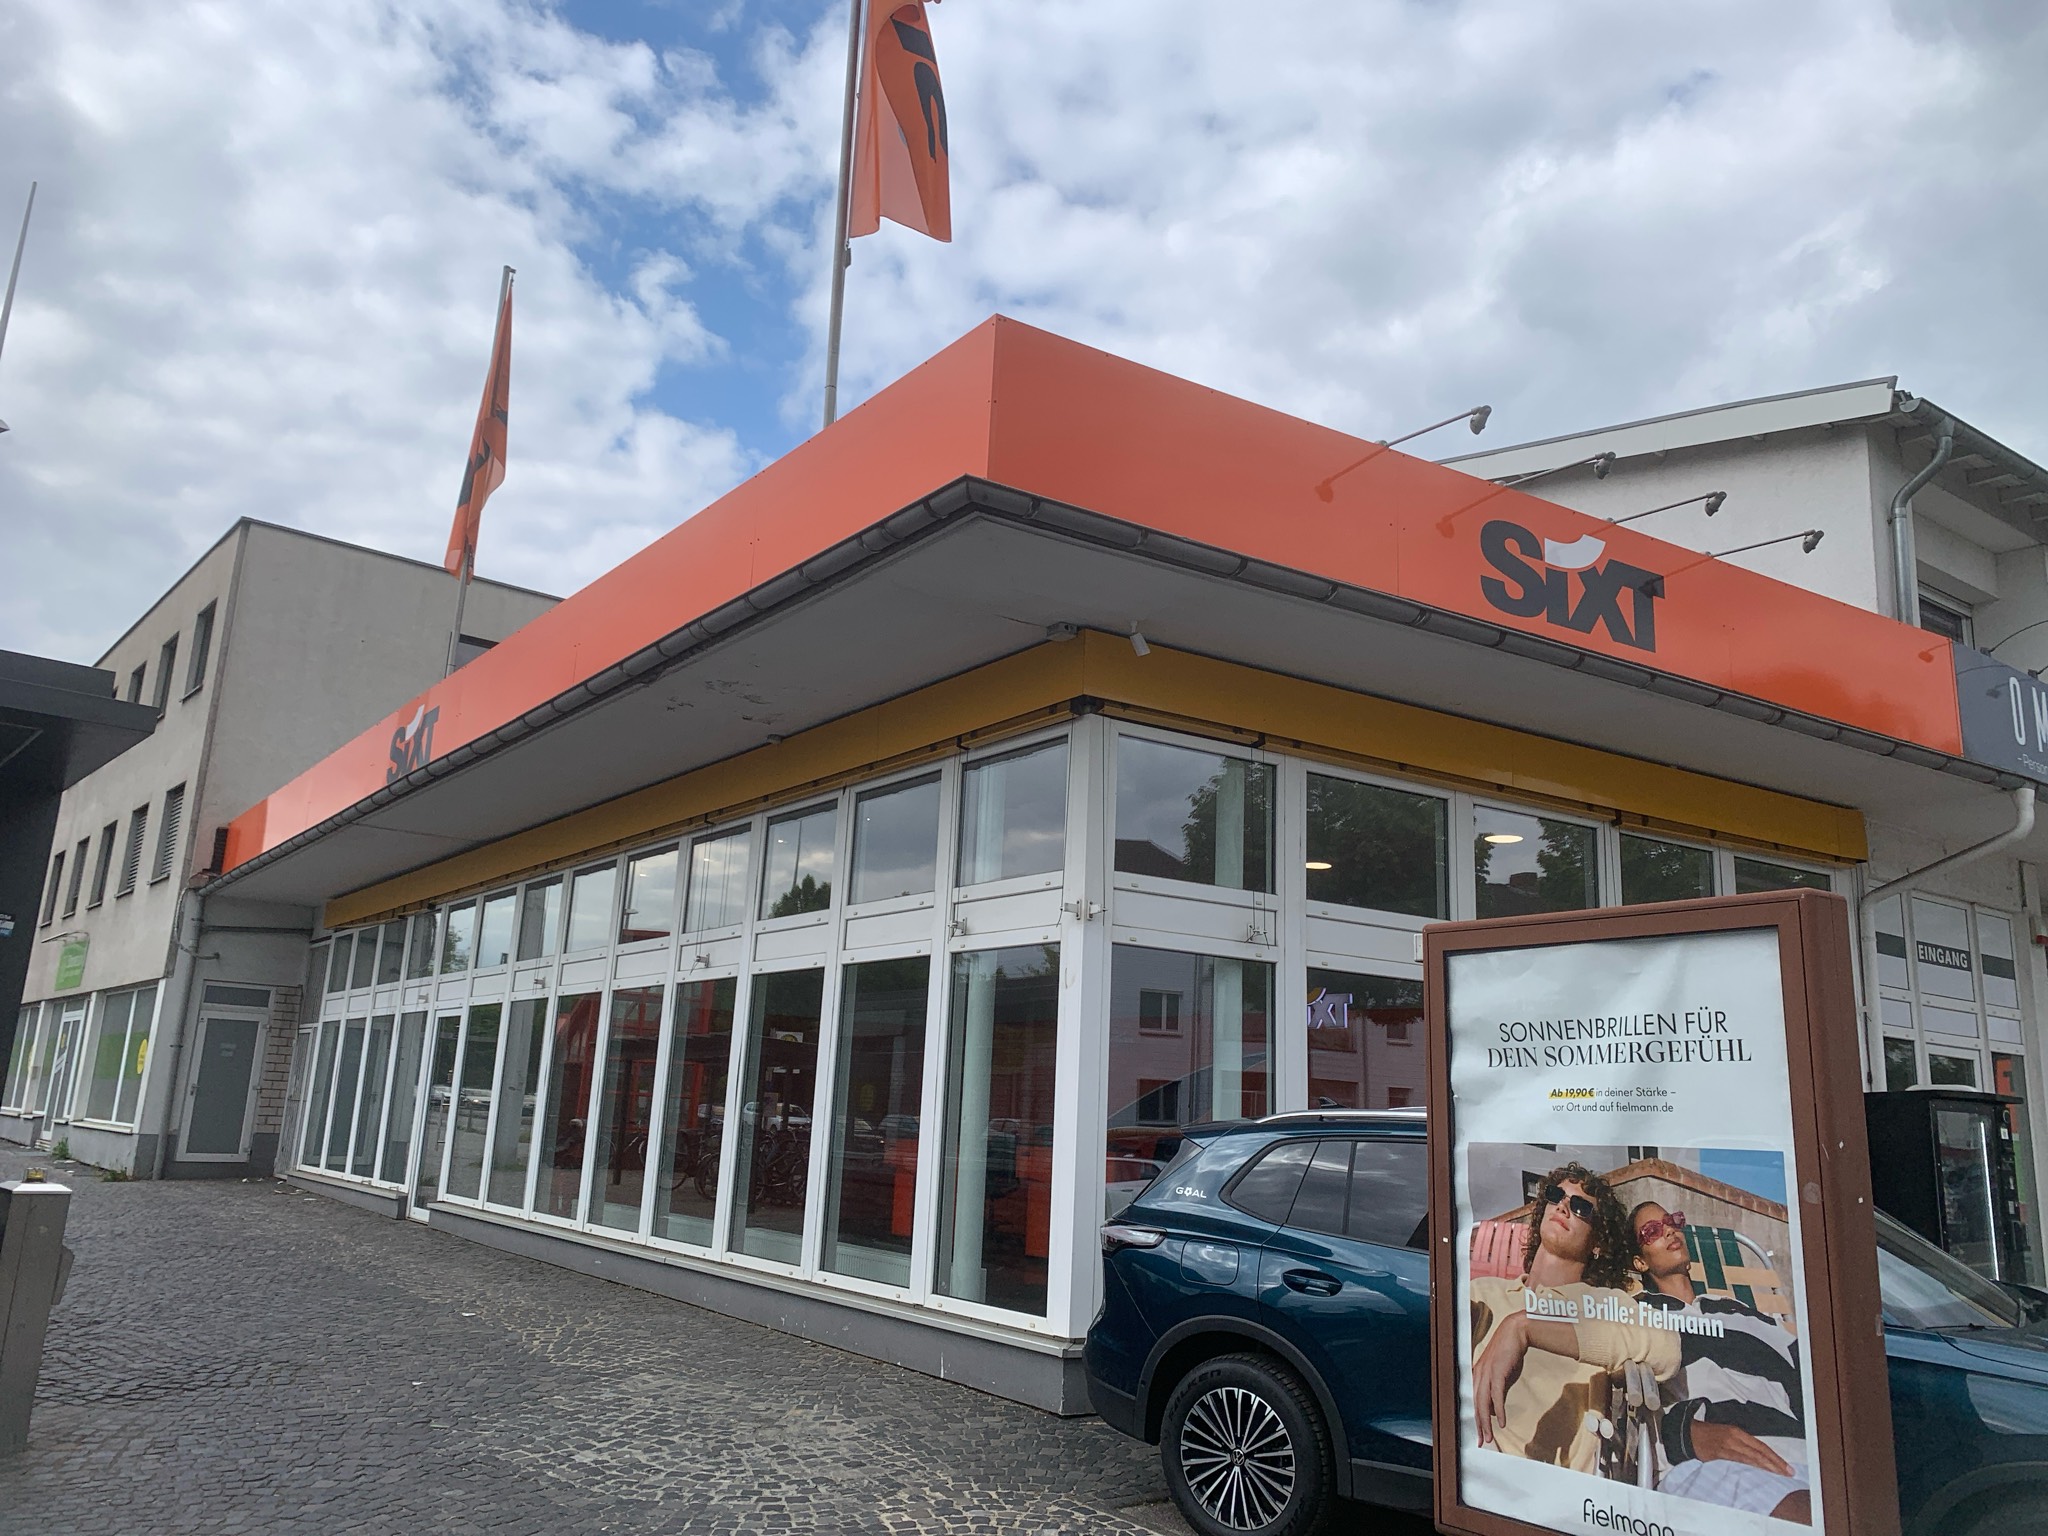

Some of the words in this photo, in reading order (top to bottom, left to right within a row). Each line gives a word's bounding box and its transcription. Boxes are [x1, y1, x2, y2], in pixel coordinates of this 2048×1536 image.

[1917, 944, 1968, 968] EINGANG
[1499, 1012, 1677, 1042] SONNENBRILLEN
[1685, 1006, 1728, 1034] FÜR
[1487, 1046, 1538, 1068] DEIN
[1544, 1035, 1752, 1068] SOMMERGEFÜHL
[1550, 1088, 1563, 1098] Ab
[1596, 1088, 1603, 1097] in
[1604, 1087, 1633, 1097] deiner
[1636, 1086, 1667, 1097] Stärke
[1566, 1102, 1580, 1111] Ort
[1582, 1102, 1597, 1111] und
[1599, 1102, 1614, 1112] auf
[1616, 1102, 1674, 1112] fielmann.de
[1175, 1186, 1207, 1198] GOAL
[1524, 1288, 1578, 1318] Deine
[1583, 1294, 1635, 1325] Brille:
[1638, 1301, 1724, 1339] Fielmann
[1583, 1498, 1675, 1536] fielmann
